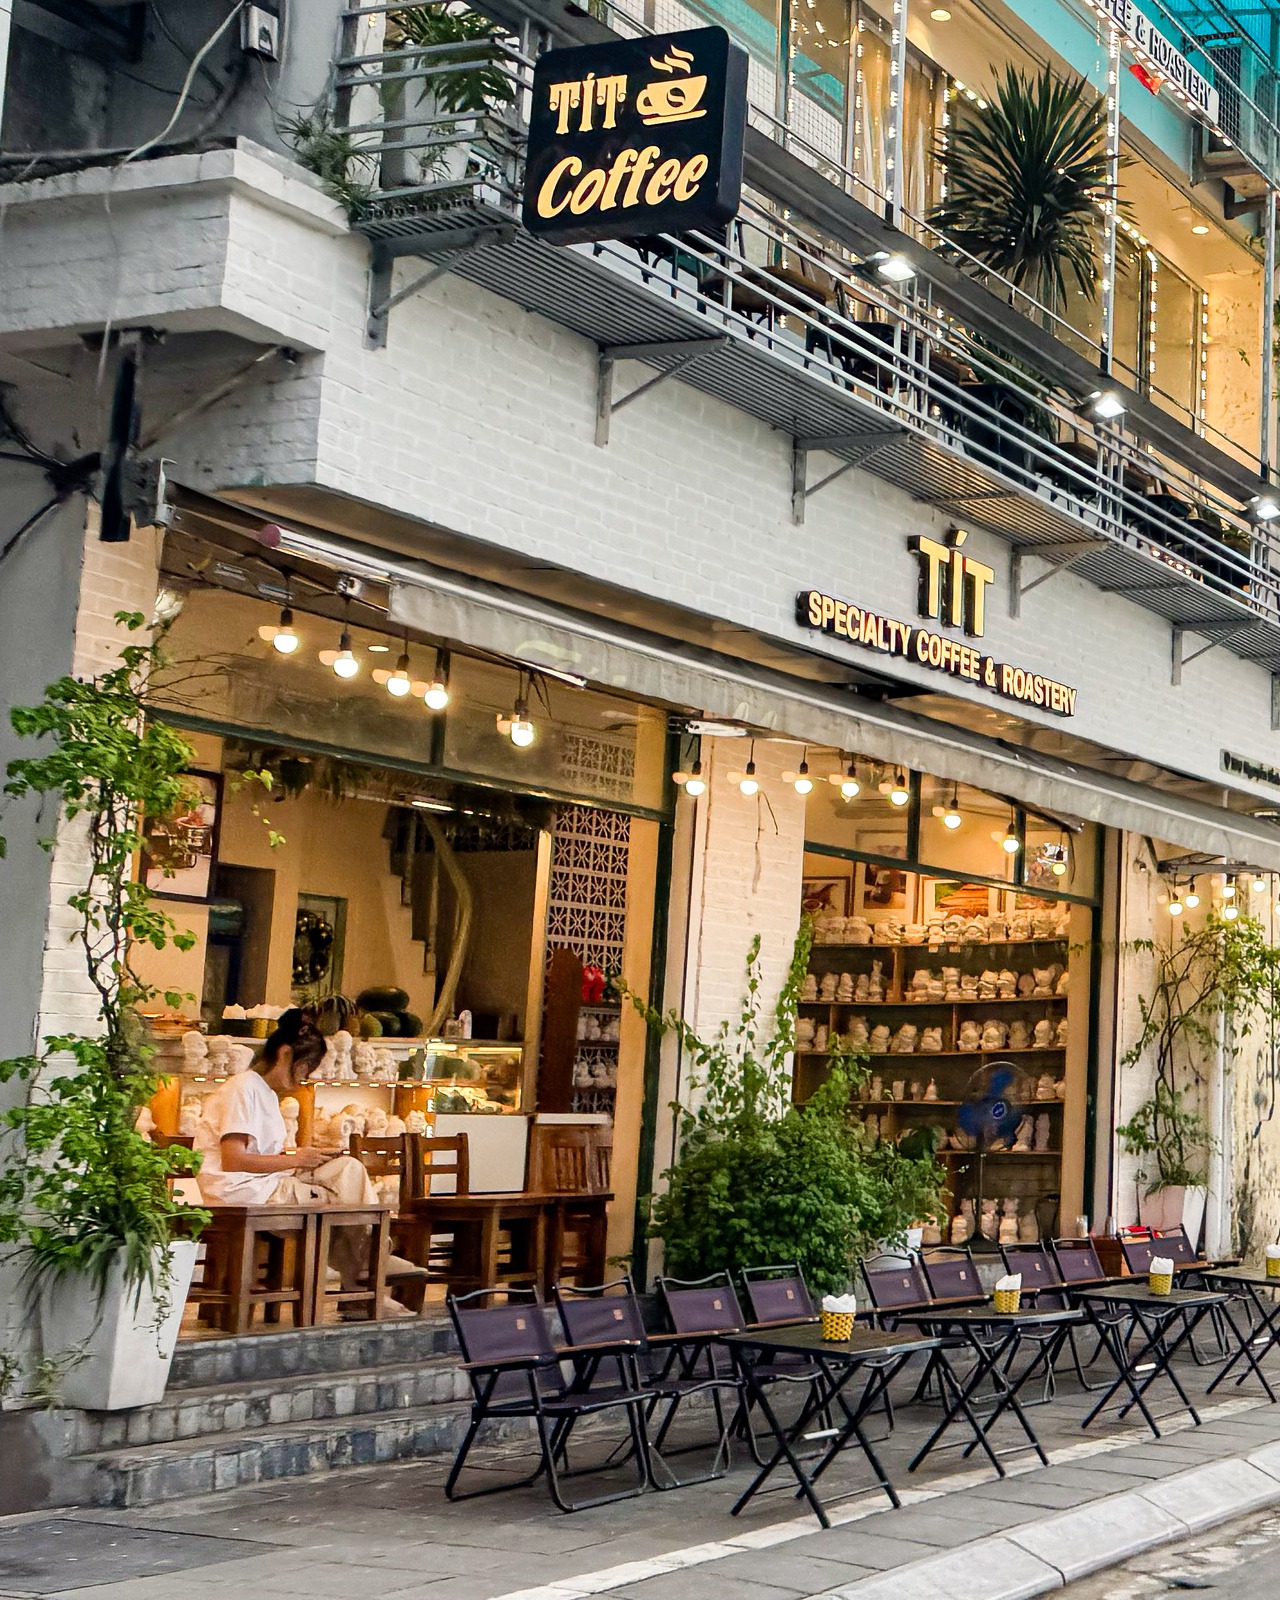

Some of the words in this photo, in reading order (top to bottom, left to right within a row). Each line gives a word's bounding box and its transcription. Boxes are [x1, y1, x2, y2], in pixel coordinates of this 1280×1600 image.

[549, 72, 628, 135] TÍT
[1148, 27, 1212, 112] ROASTERY
[536, 145, 709, 219] Coffee
[916, 528, 996, 638] TÍT
[807, 590, 912, 656] SPECIALTY
[915, 628, 982, 681] COFFEE
[984, 656, 997, 687] &
[1001, 662, 1078, 717] ROASTERY
